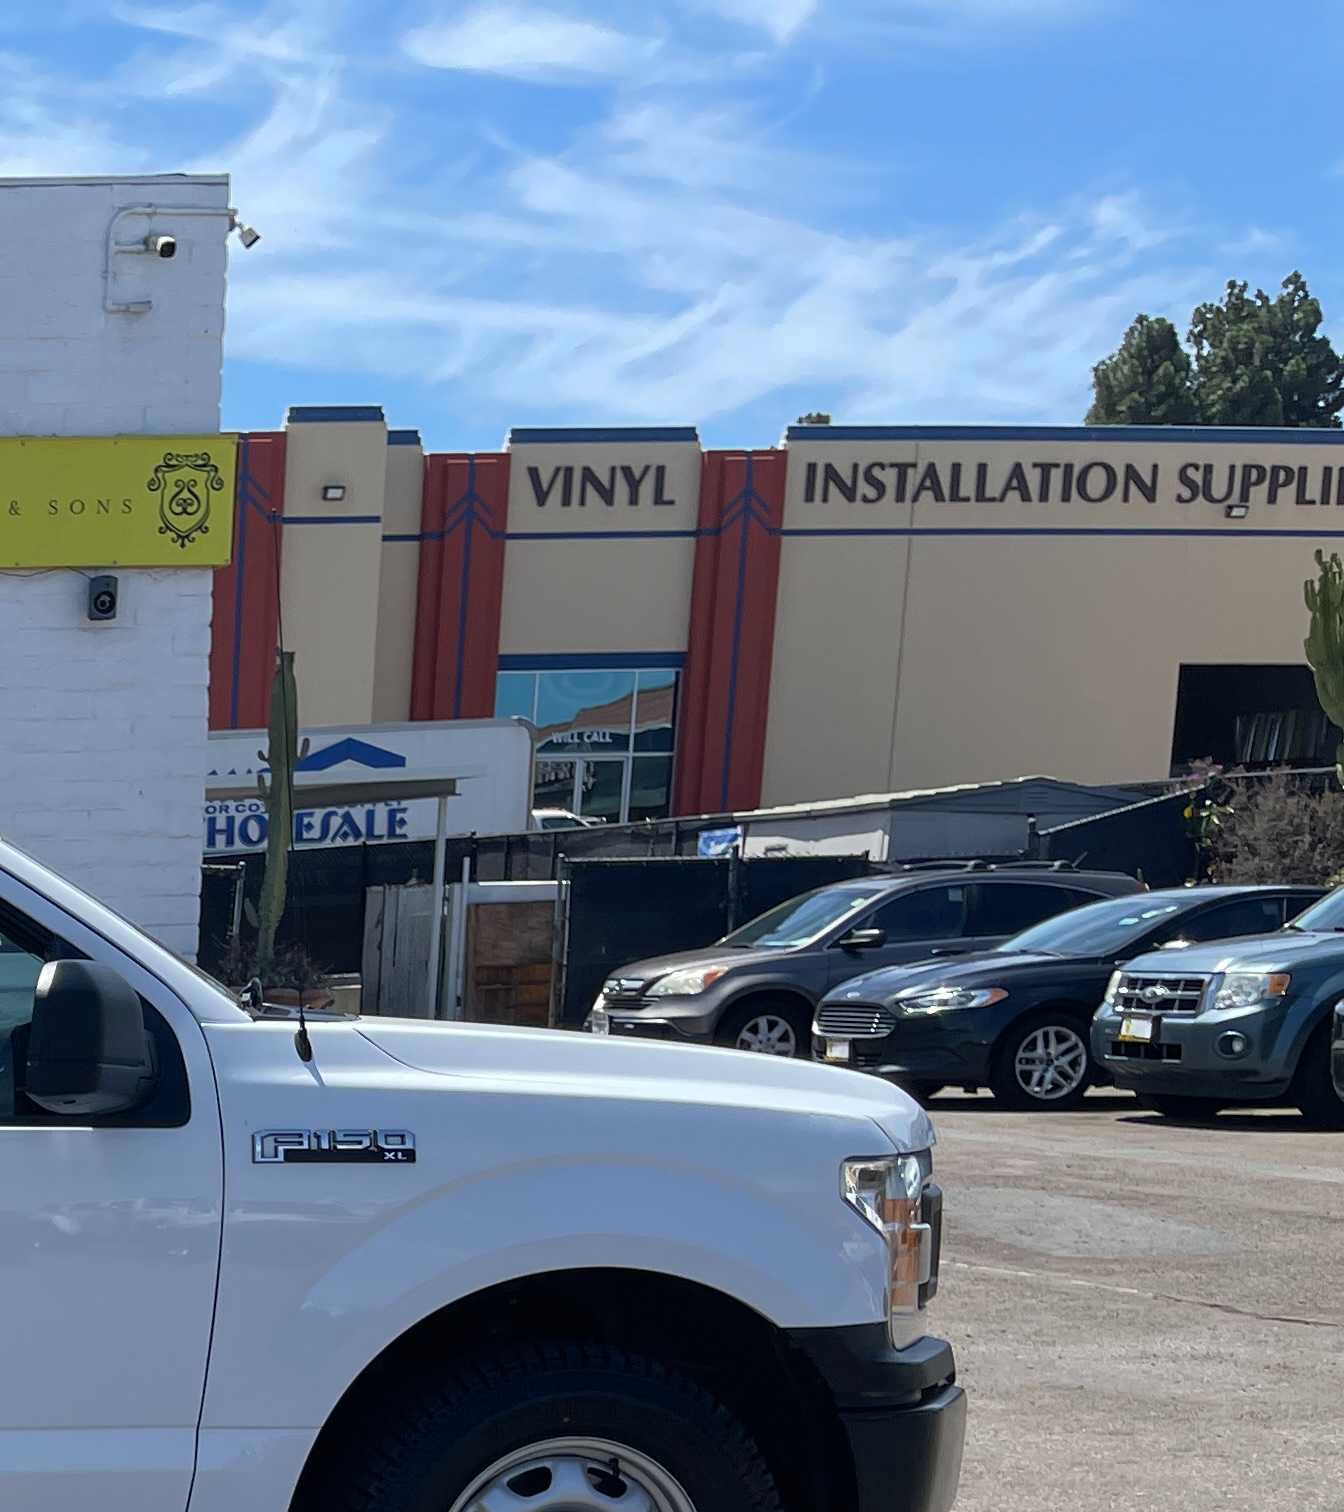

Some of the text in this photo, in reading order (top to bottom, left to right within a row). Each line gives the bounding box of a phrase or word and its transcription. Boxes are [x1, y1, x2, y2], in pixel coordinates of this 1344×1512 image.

[525, 464, 676, 508] VINYL
[804, 461, 1159, 504] INSTALLATION
[7, 499, 22, 516] &
[47, 498, 134, 516] SONS
[583, 730, 613, 743] CALL
[383, 1151, 408, 1161] XL
